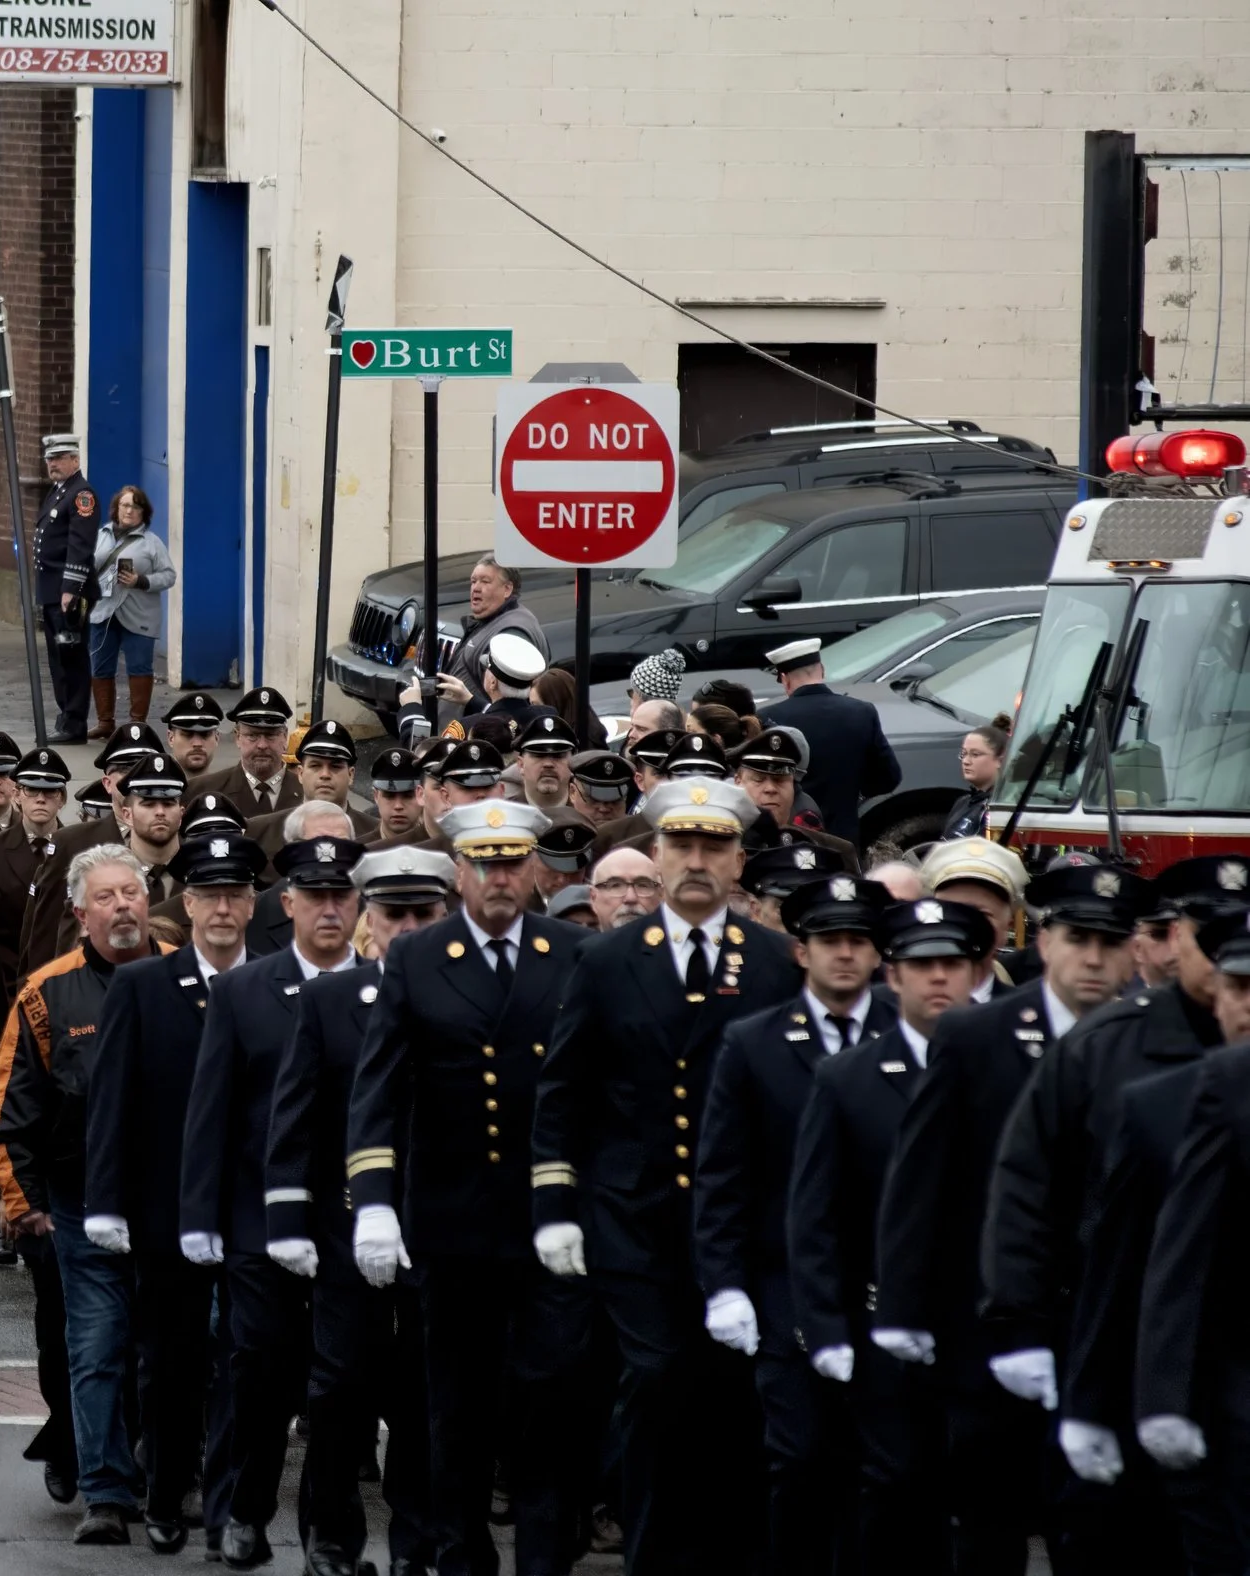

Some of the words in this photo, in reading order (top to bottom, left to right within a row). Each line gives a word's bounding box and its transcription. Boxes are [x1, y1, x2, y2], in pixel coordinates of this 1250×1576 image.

[380, 339, 481, 368] Burt
[488, 338, 507, 360] St
[528, 423, 569, 450] DO
[589, 423, 649, 450] NOT
[538, 502, 635, 529] ENTER
[69, 1024, 96, 1037] Scott
